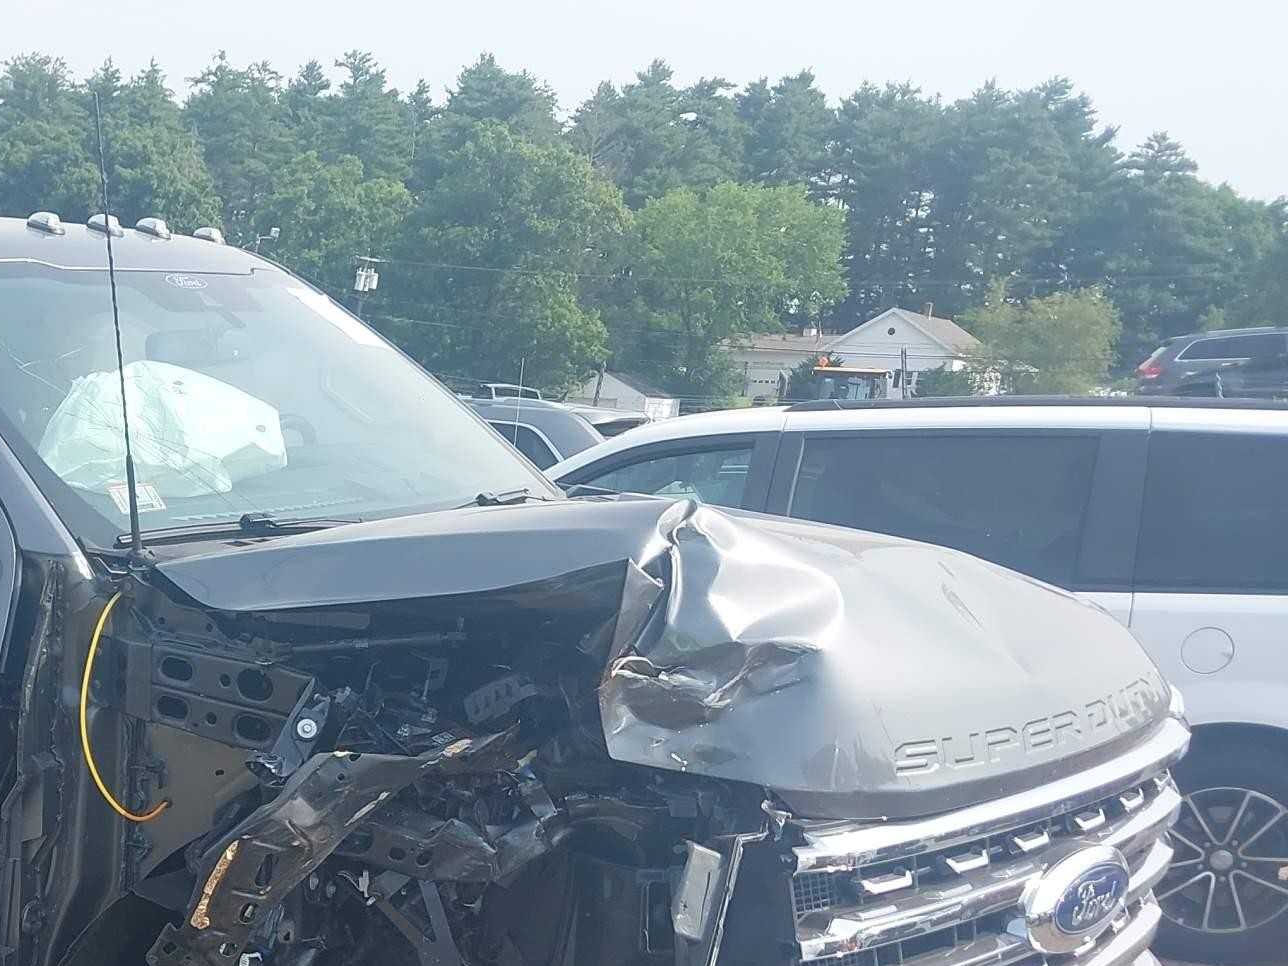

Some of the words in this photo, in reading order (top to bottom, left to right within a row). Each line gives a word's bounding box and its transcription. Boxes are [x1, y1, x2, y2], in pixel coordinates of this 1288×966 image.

[894, 710, 1081, 777] SUPER
[1084, 676, 1161, 733] DUTY
[1072, 875, 1117, 926] Ford
